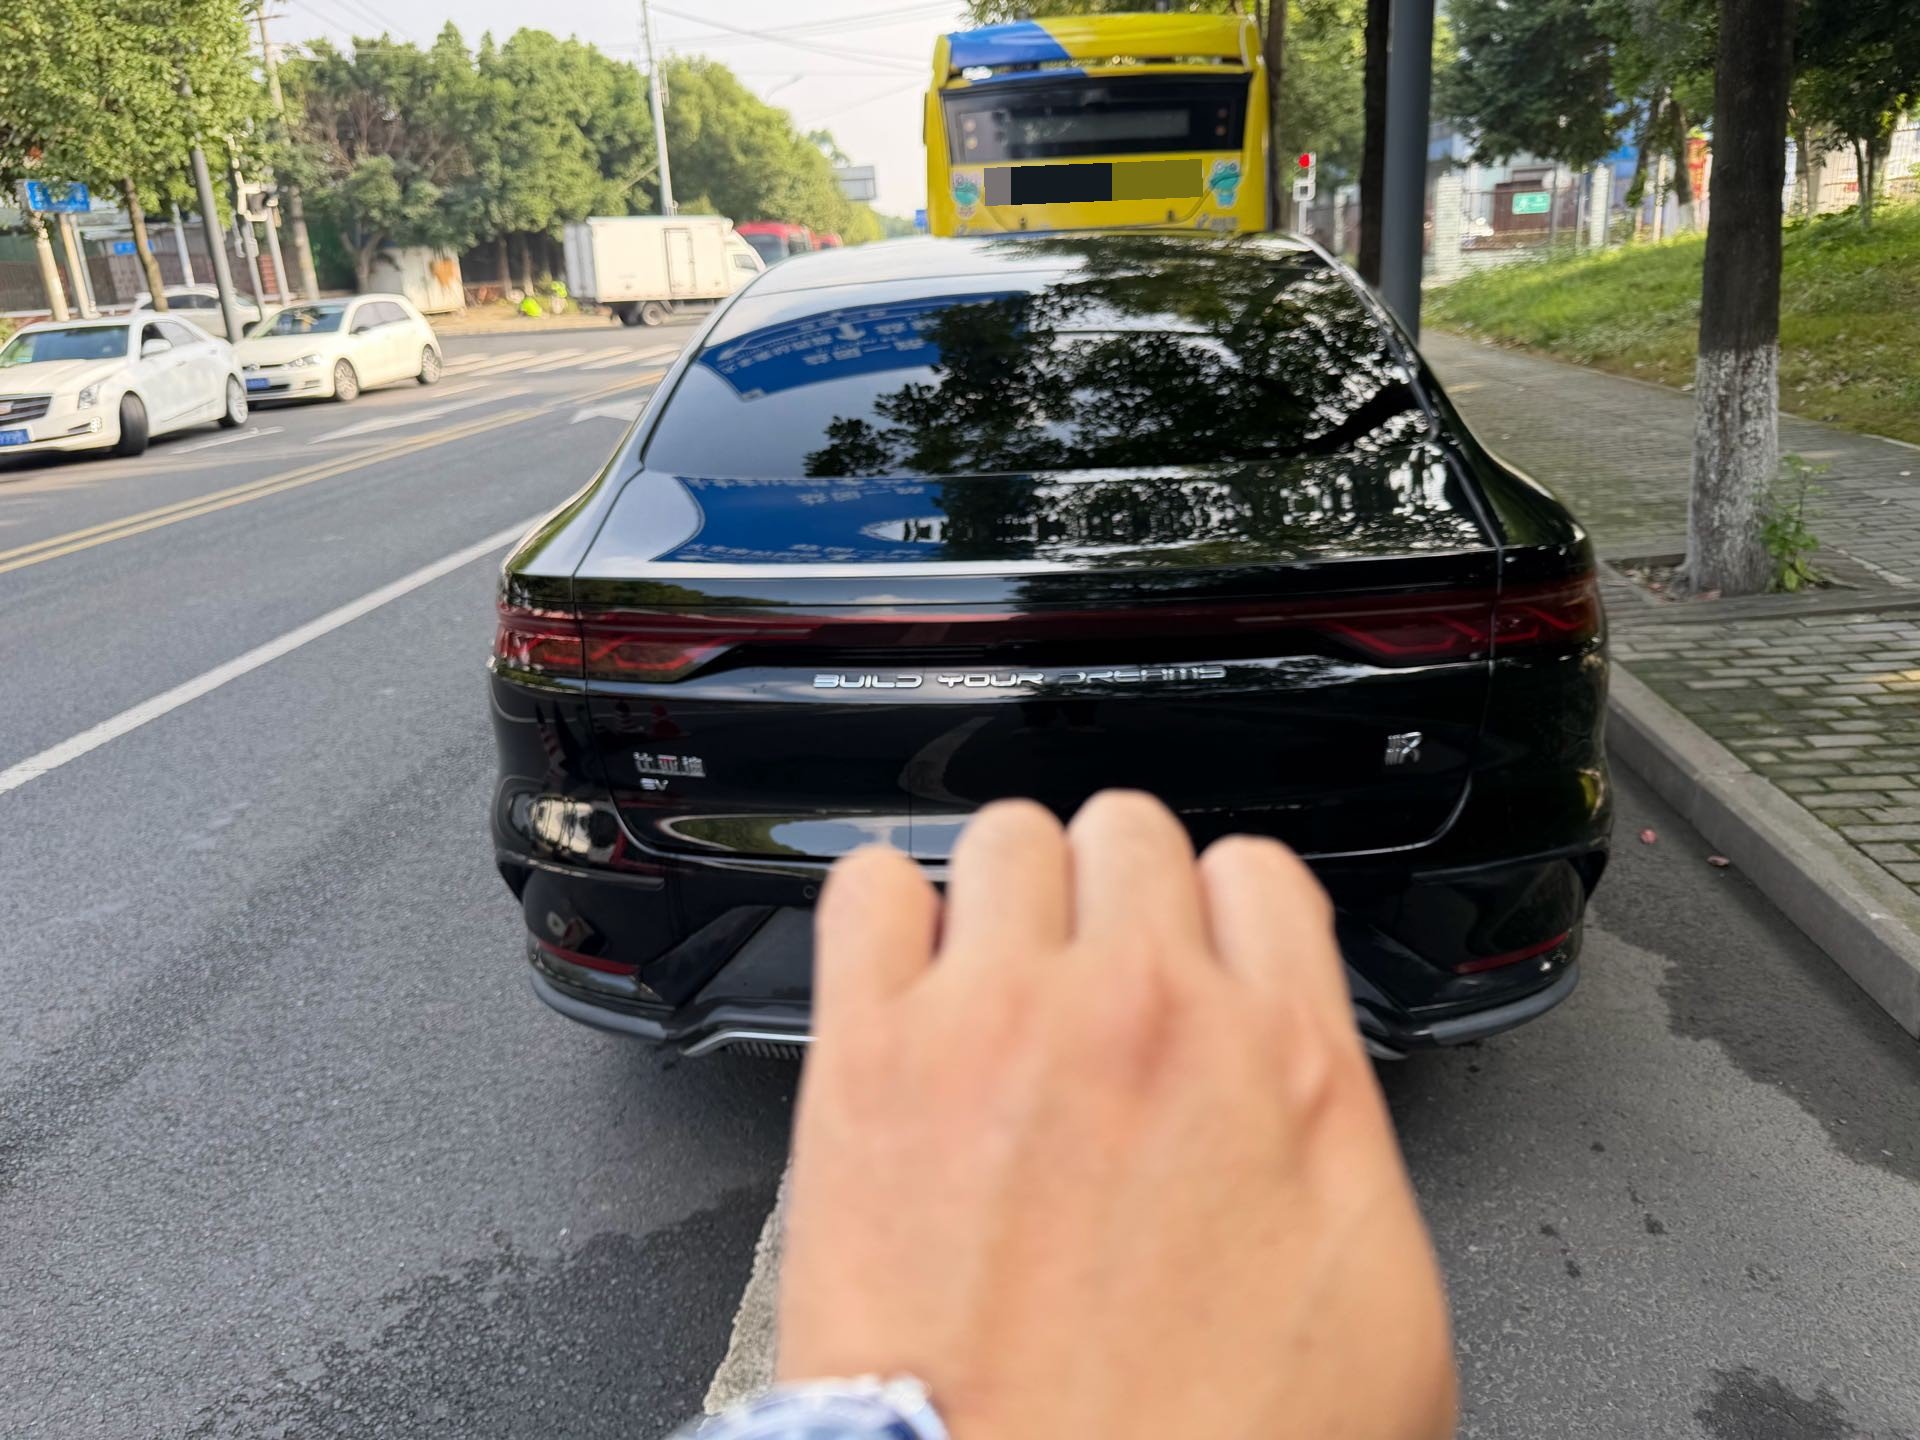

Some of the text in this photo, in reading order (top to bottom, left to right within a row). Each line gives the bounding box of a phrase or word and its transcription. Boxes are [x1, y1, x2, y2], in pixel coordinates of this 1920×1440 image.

[813, 665, 1227, 688] BUILD YOUR DREAMS
[633, 751, 706, 777] 比亚迪
[640, 777, 669, 791] EV
